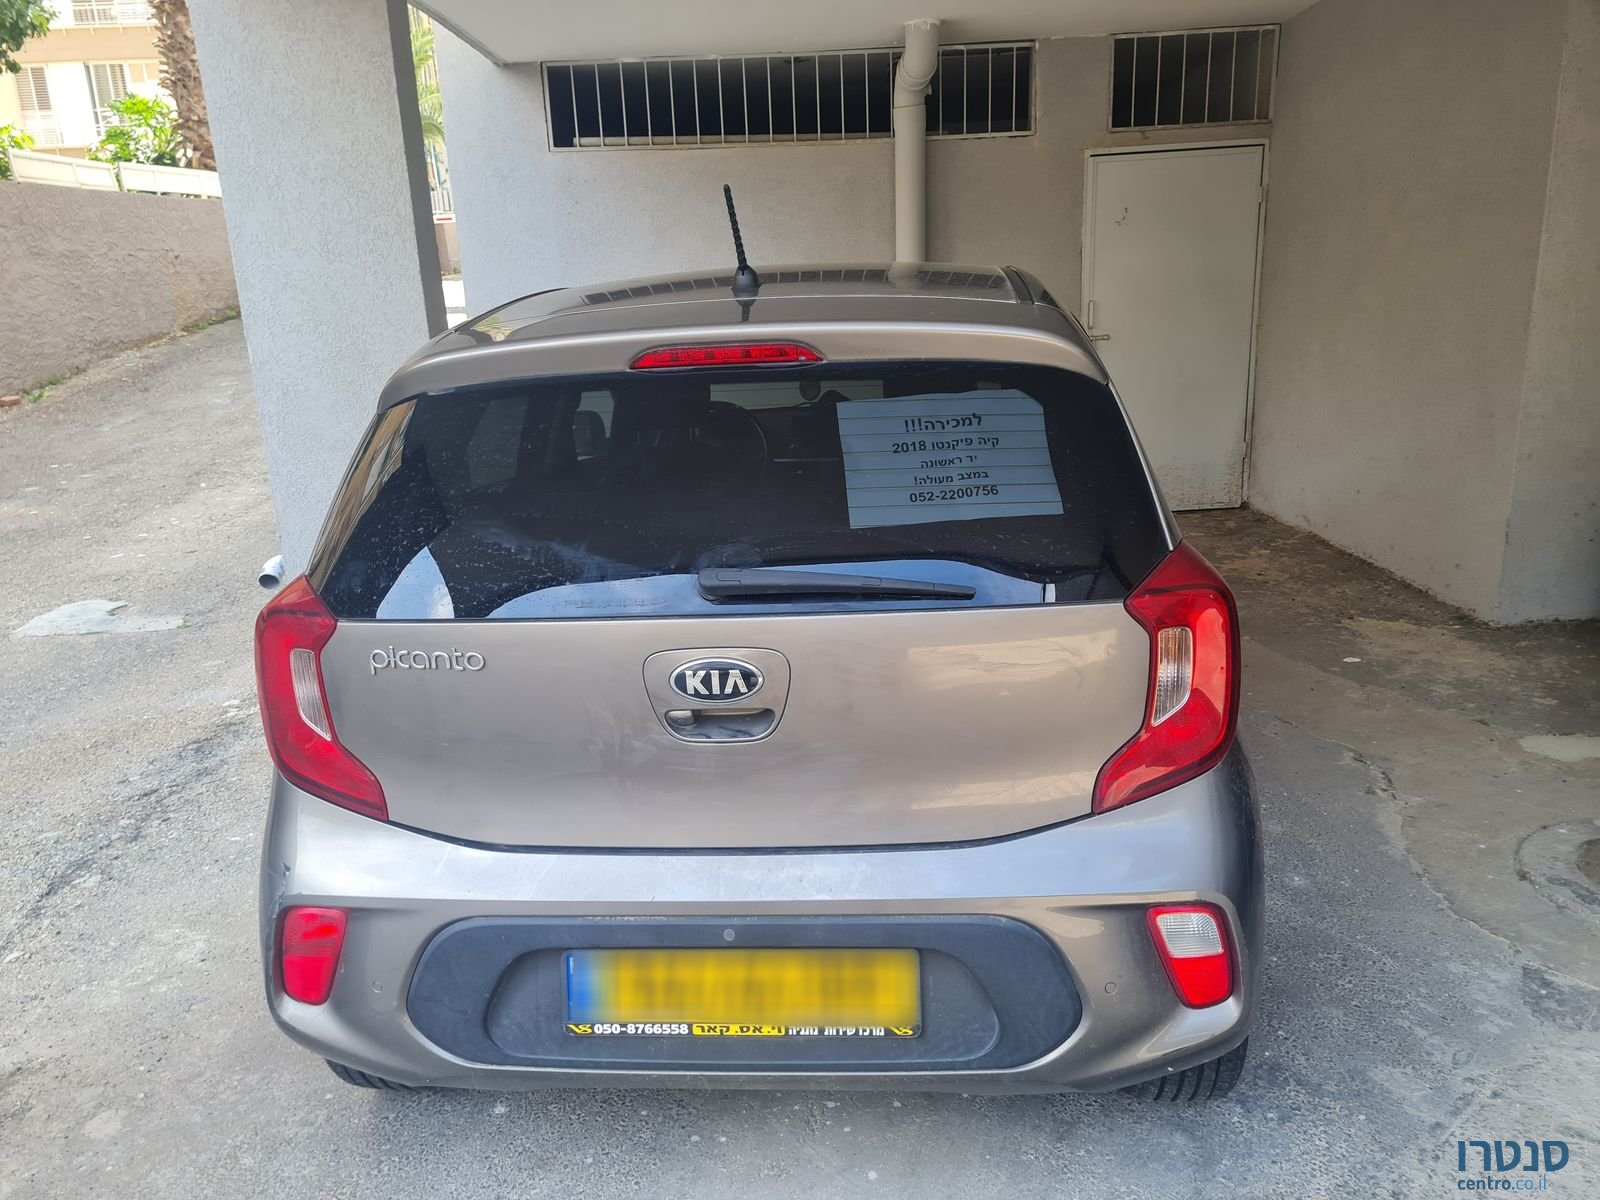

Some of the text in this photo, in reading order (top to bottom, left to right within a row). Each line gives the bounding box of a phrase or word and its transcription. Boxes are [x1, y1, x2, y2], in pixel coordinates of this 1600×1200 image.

[904, 412, 983, 432] למכירה!!!
[892, 436, 1000, 454] קיה פיקנטו 2018
[920, 455, 977, 469] יד ראשונה
[914, 471, 989, 486] במצב מעולה!
[909, 484, 999, 503] 052-2200756
[370, 645, 486, 675] picanto
[684, 670, 750, 695] KIA
[594, 1023, 689, 1034] 050-8766558
[696, 1025, 730, 1035] קאר
